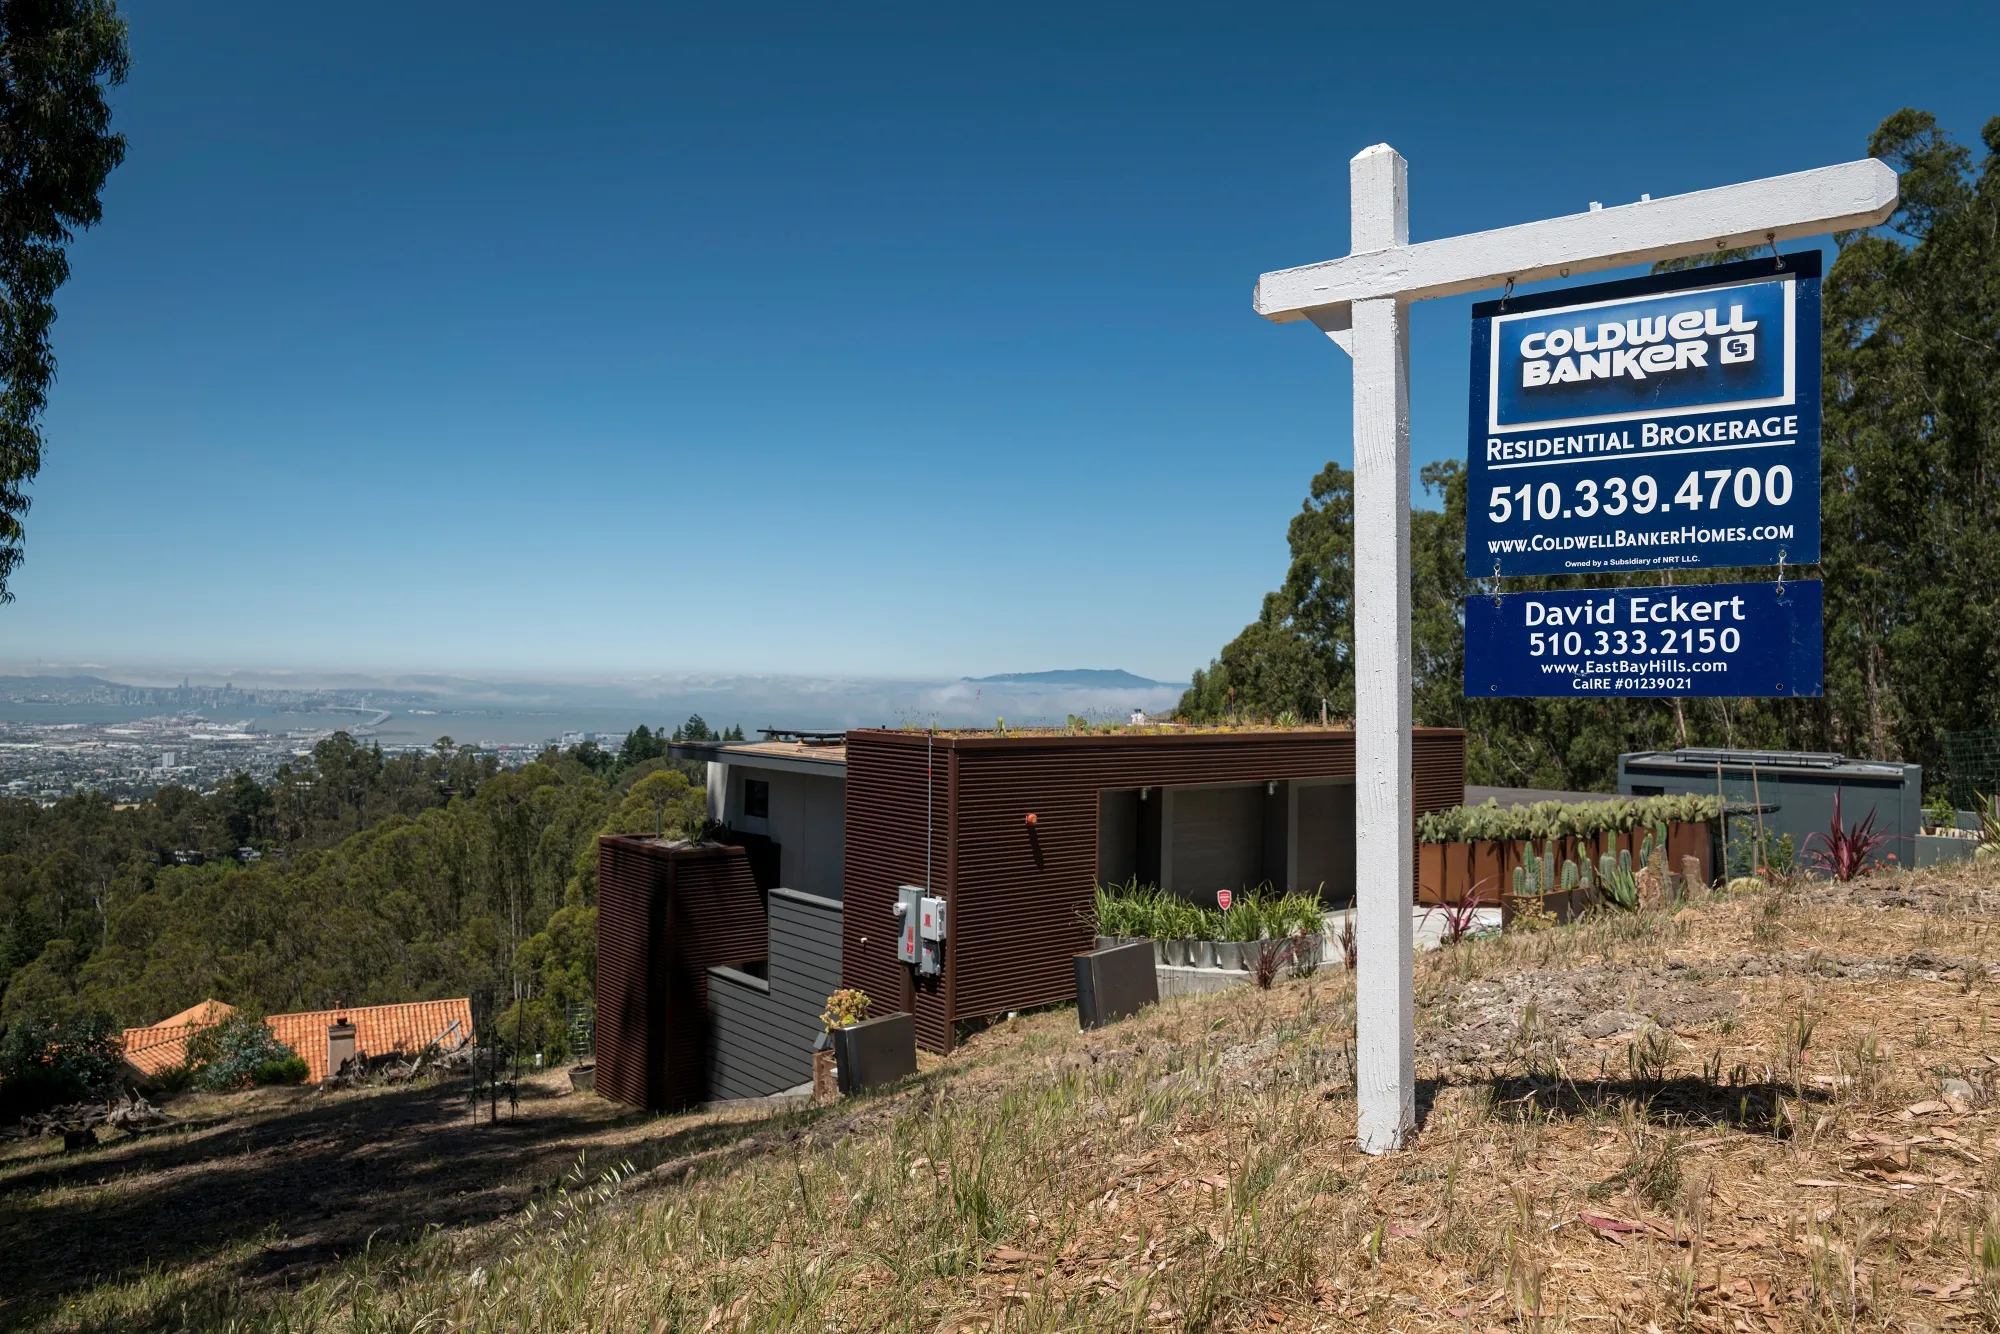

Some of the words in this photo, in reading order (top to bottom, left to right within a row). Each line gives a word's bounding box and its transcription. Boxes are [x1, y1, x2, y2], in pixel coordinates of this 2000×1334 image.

[1487, 431, 1635, 461] RESIDENTIAL
[1641, 415, 1798, 448] BROKERAGE
[1488, 464, 1793, 523] 510.339.4700
[1564, 560, 1591, 568] Owned
[1592, 559, 1602, 568] by
[1610, 557, 1651, 566] Subsidiary
[1653, 555, 1661, 564] of
[1662, 556, 1680, 564] NRT
[1525, 598, 1615, 627] David
[1630, 595, 1746, 624] Eckert
[1529, 627, 1741, 657] 510.333.2150
[1540, 659, 1728, 676] www.EastBayHills.com
[1614, 677, 1692, 690] #01239021
